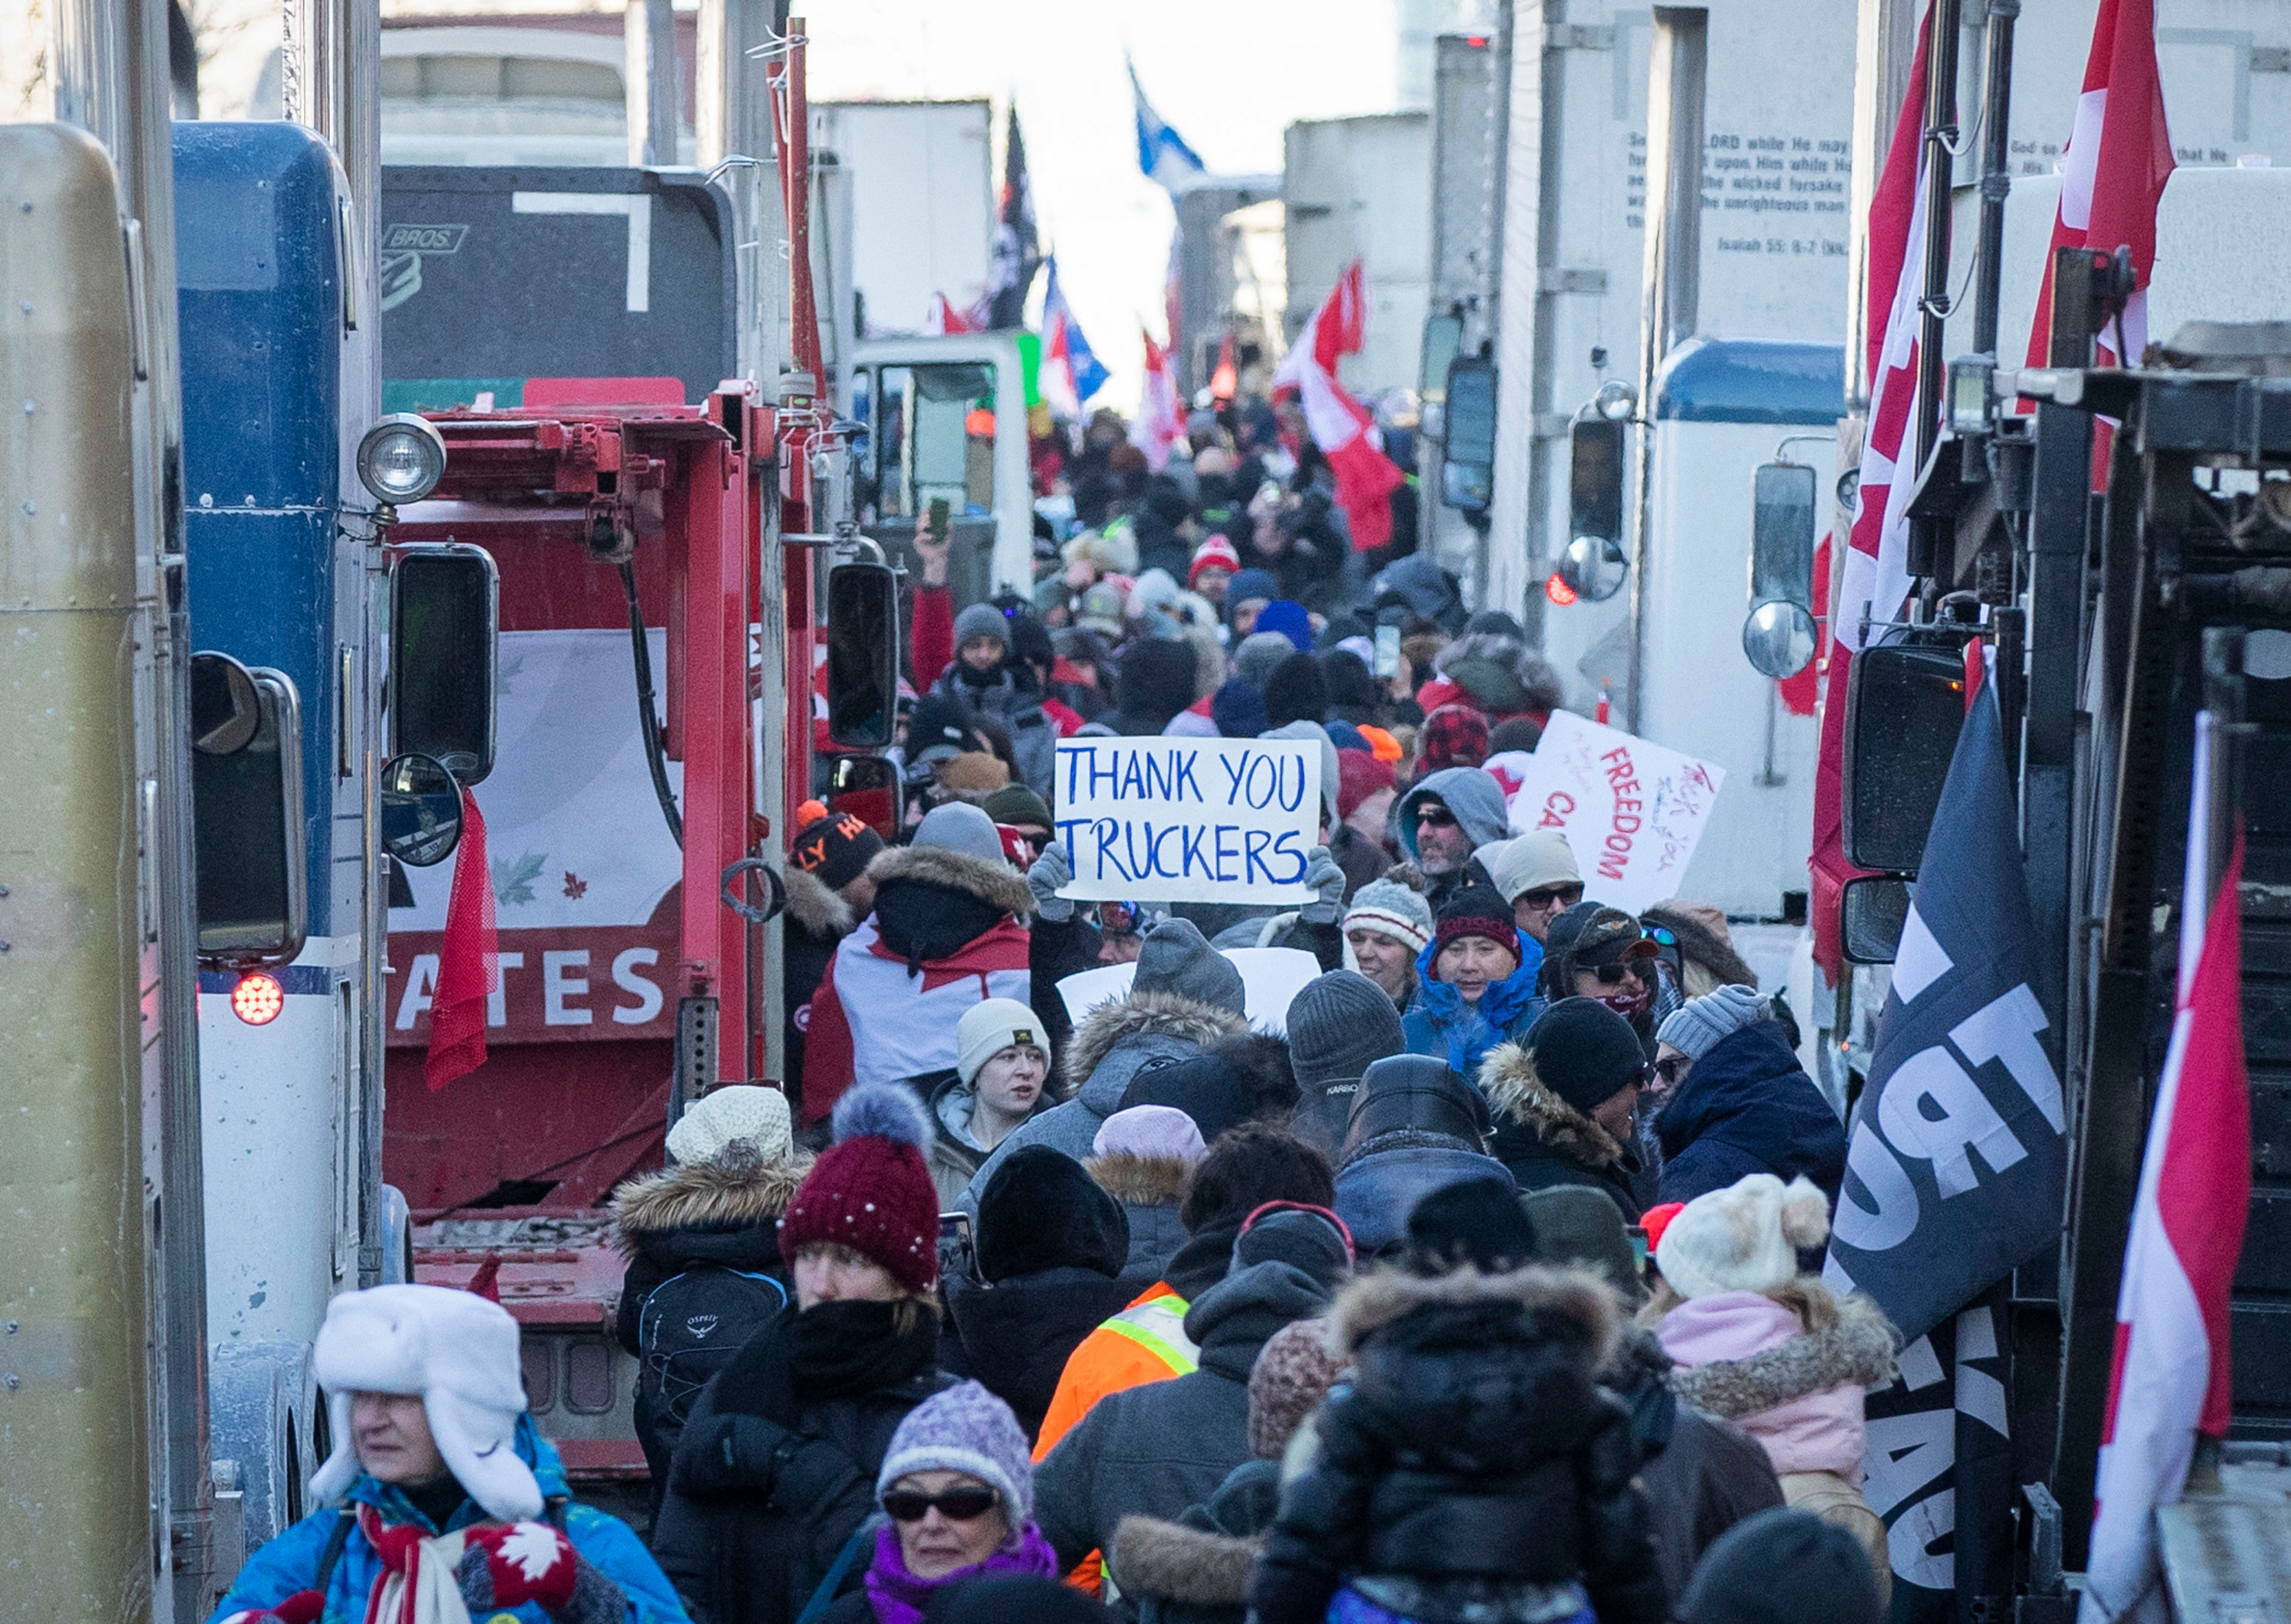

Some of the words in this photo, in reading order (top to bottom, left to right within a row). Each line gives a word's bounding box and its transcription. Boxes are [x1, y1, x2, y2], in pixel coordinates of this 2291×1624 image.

[1748, 136, 1784, 152] while
[1792, 137, 1811, 151] He
[1818, 138, 1848, 154] may
[1756, 156, 1784, 170] Him
[1789, 157, 1829, 172] while
[1733, 175, 1781, 192] wicked
[1790, 177, 1844, 192] forsake
[1725, 196, 1810, 214] unrighteous
[1814, 199, 1847, 213] man
[1057, 746, 1204, 806] THANK
[1219, 749, 1306, 813] YOU
[1538, 790, 1576, 830] CA
[1597, 746, 1643, 881] FREEDOM
[1055, 816, 1309, 886] TRUCKERS
[1326, 1084, 1359, 1096] KARBO
[687, 1314, 719, 1324] OSPREY
